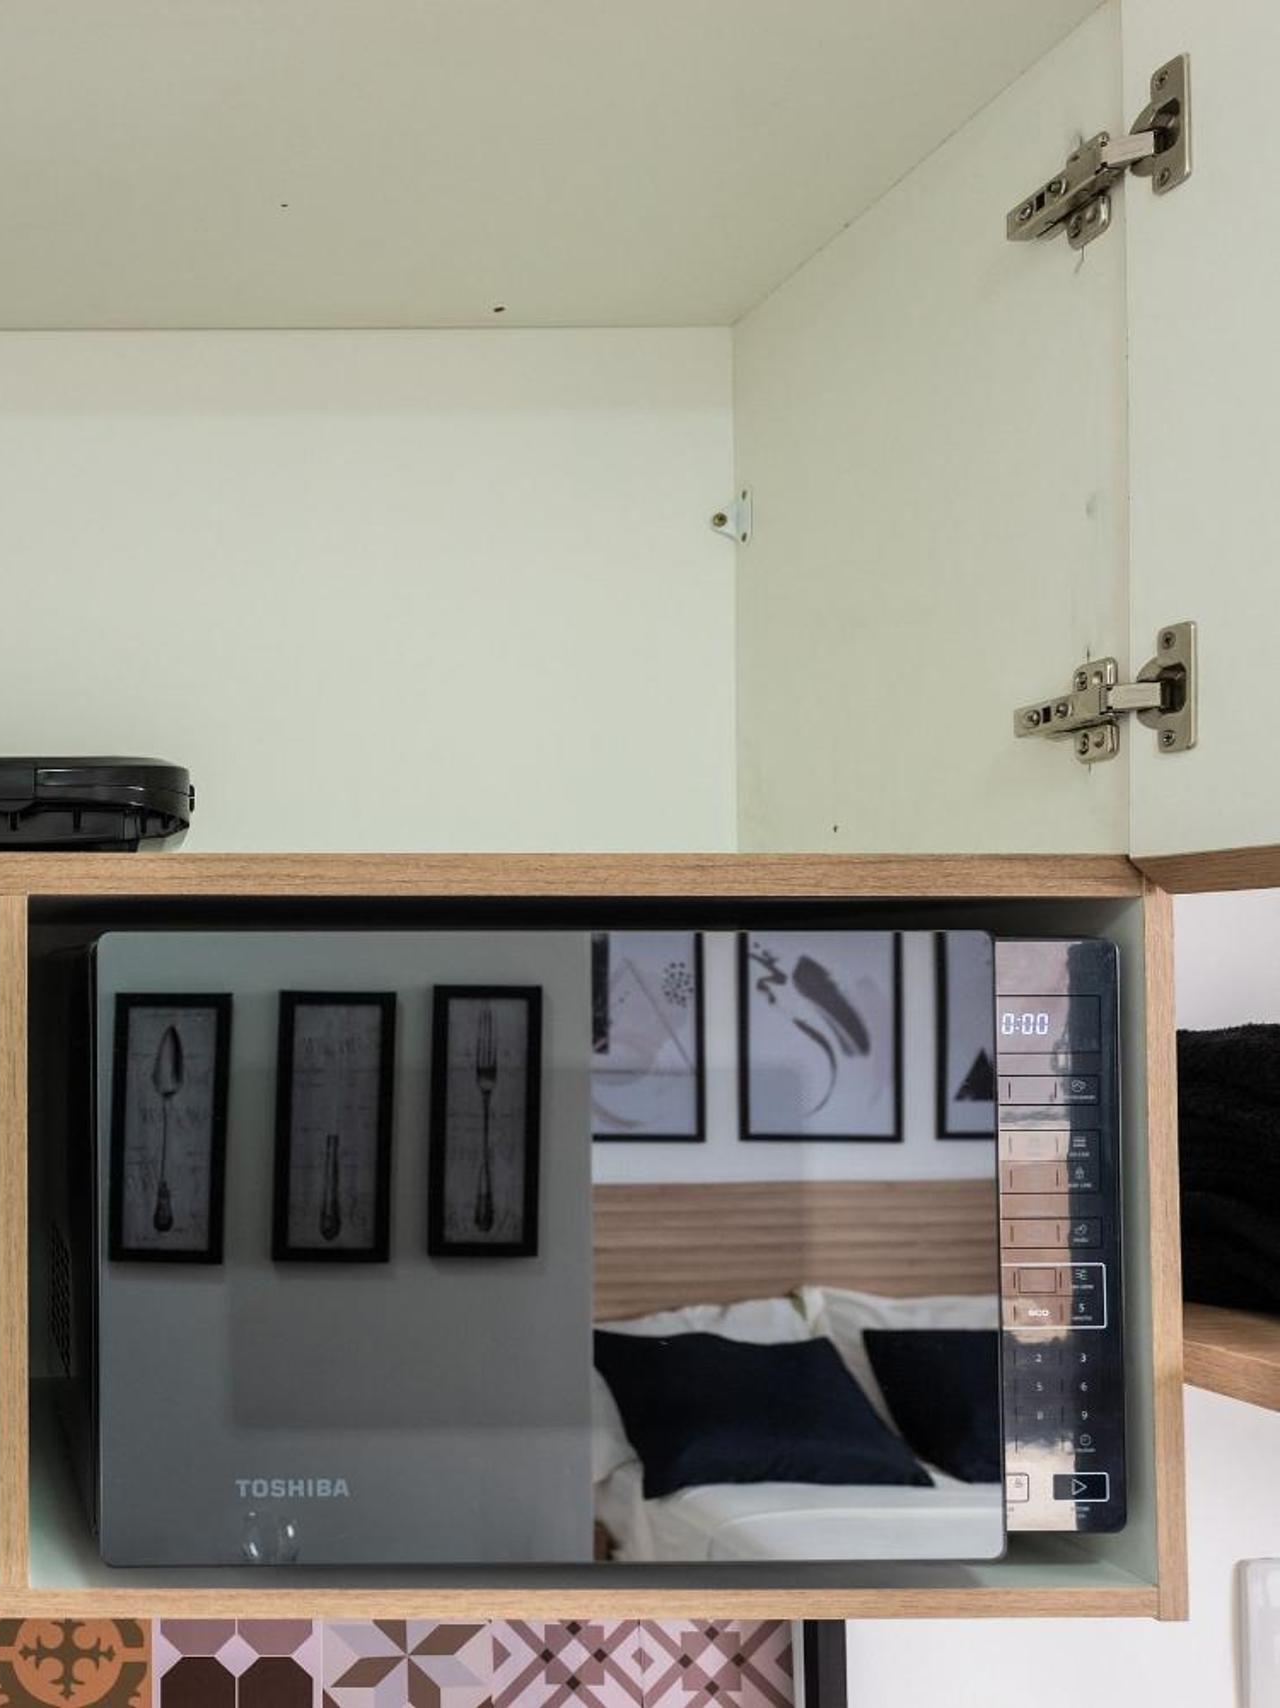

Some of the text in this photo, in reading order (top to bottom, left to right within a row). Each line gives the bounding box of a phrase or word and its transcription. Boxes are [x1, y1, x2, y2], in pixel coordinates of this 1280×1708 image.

[1001, 1013, 1049, 1035] 0:00
[1035, 1353, 1042, 1363] 2
[1080, 1352, 1087, 1363] 3
[1080, 1381, 1088, 1392] 6
[1081, 1410, 1088, 1421] 9
[235, 1478, 350, 1498] TOSHIBA
